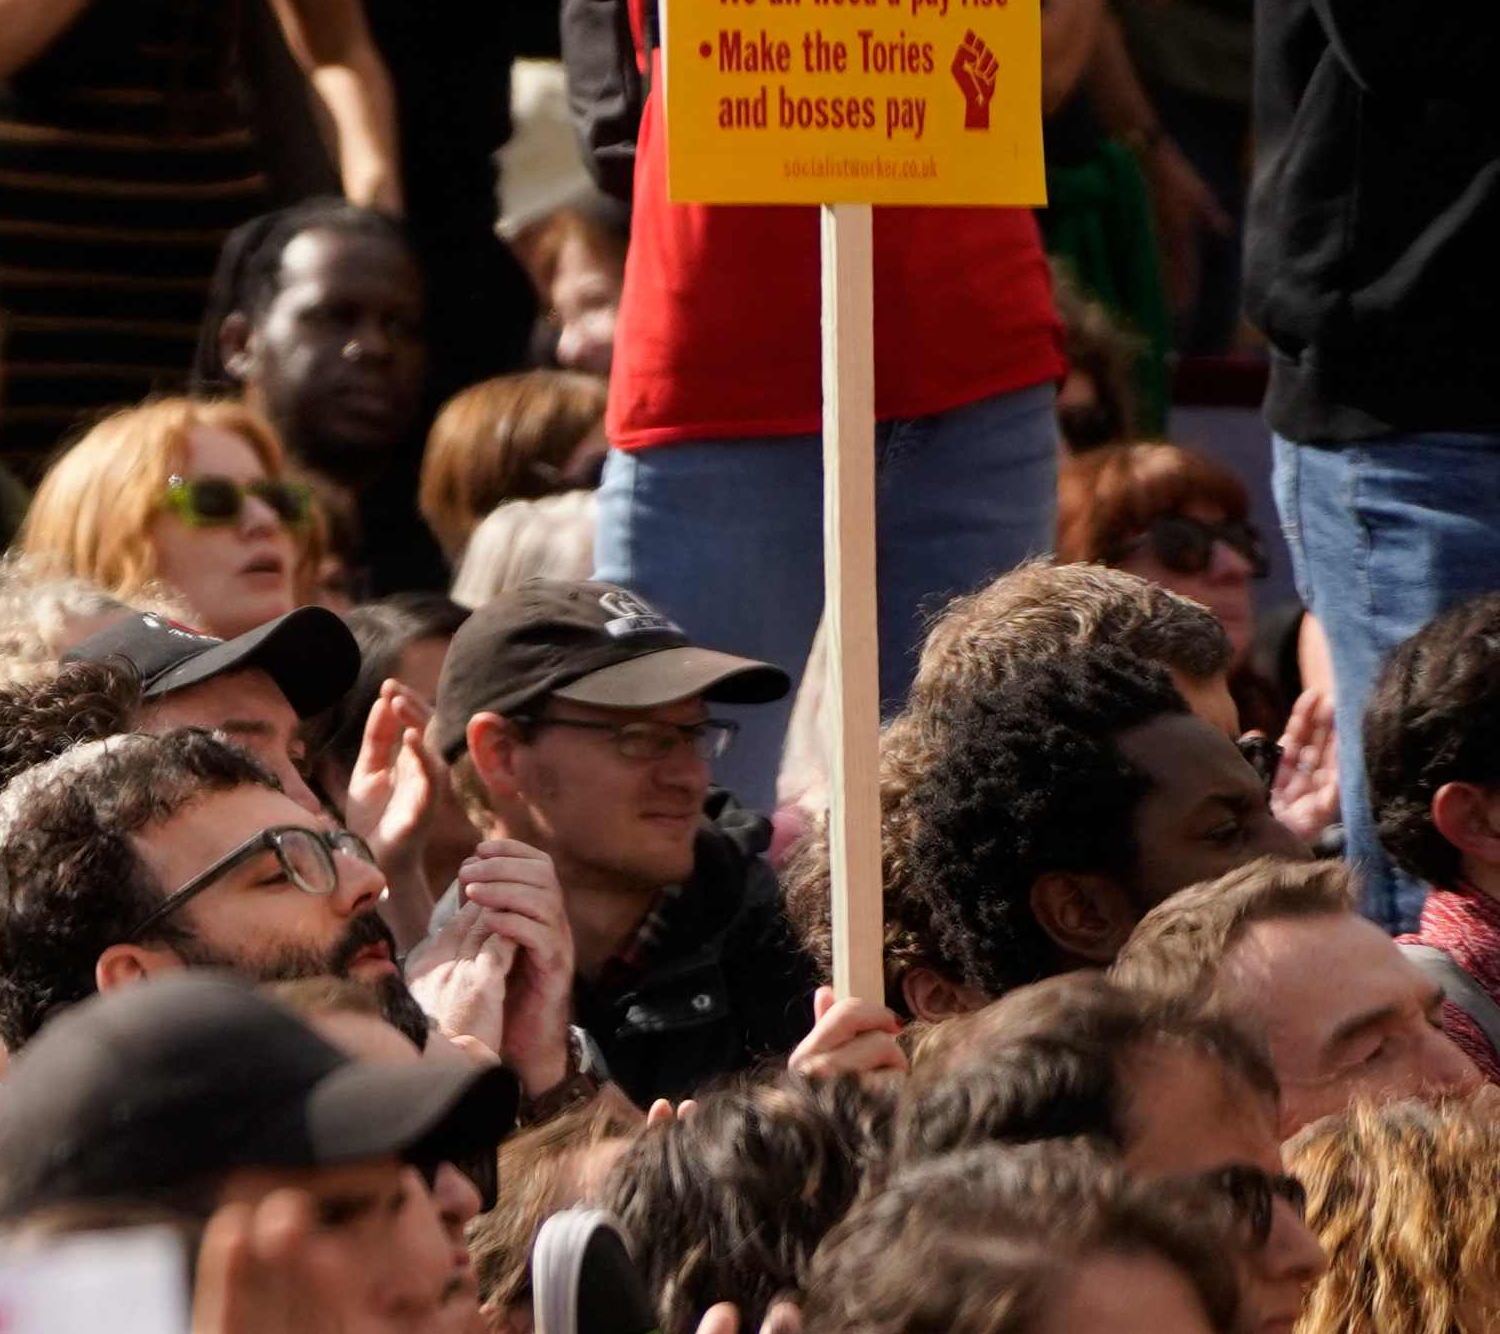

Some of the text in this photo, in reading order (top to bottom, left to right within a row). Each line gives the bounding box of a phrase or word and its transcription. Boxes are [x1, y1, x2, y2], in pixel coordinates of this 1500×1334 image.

[718, 29, 935, 75] Make the Tories
[718, 86, 927, 140] and bosses pay
[783, 153, 938, 179] socialistworker.co.uk
